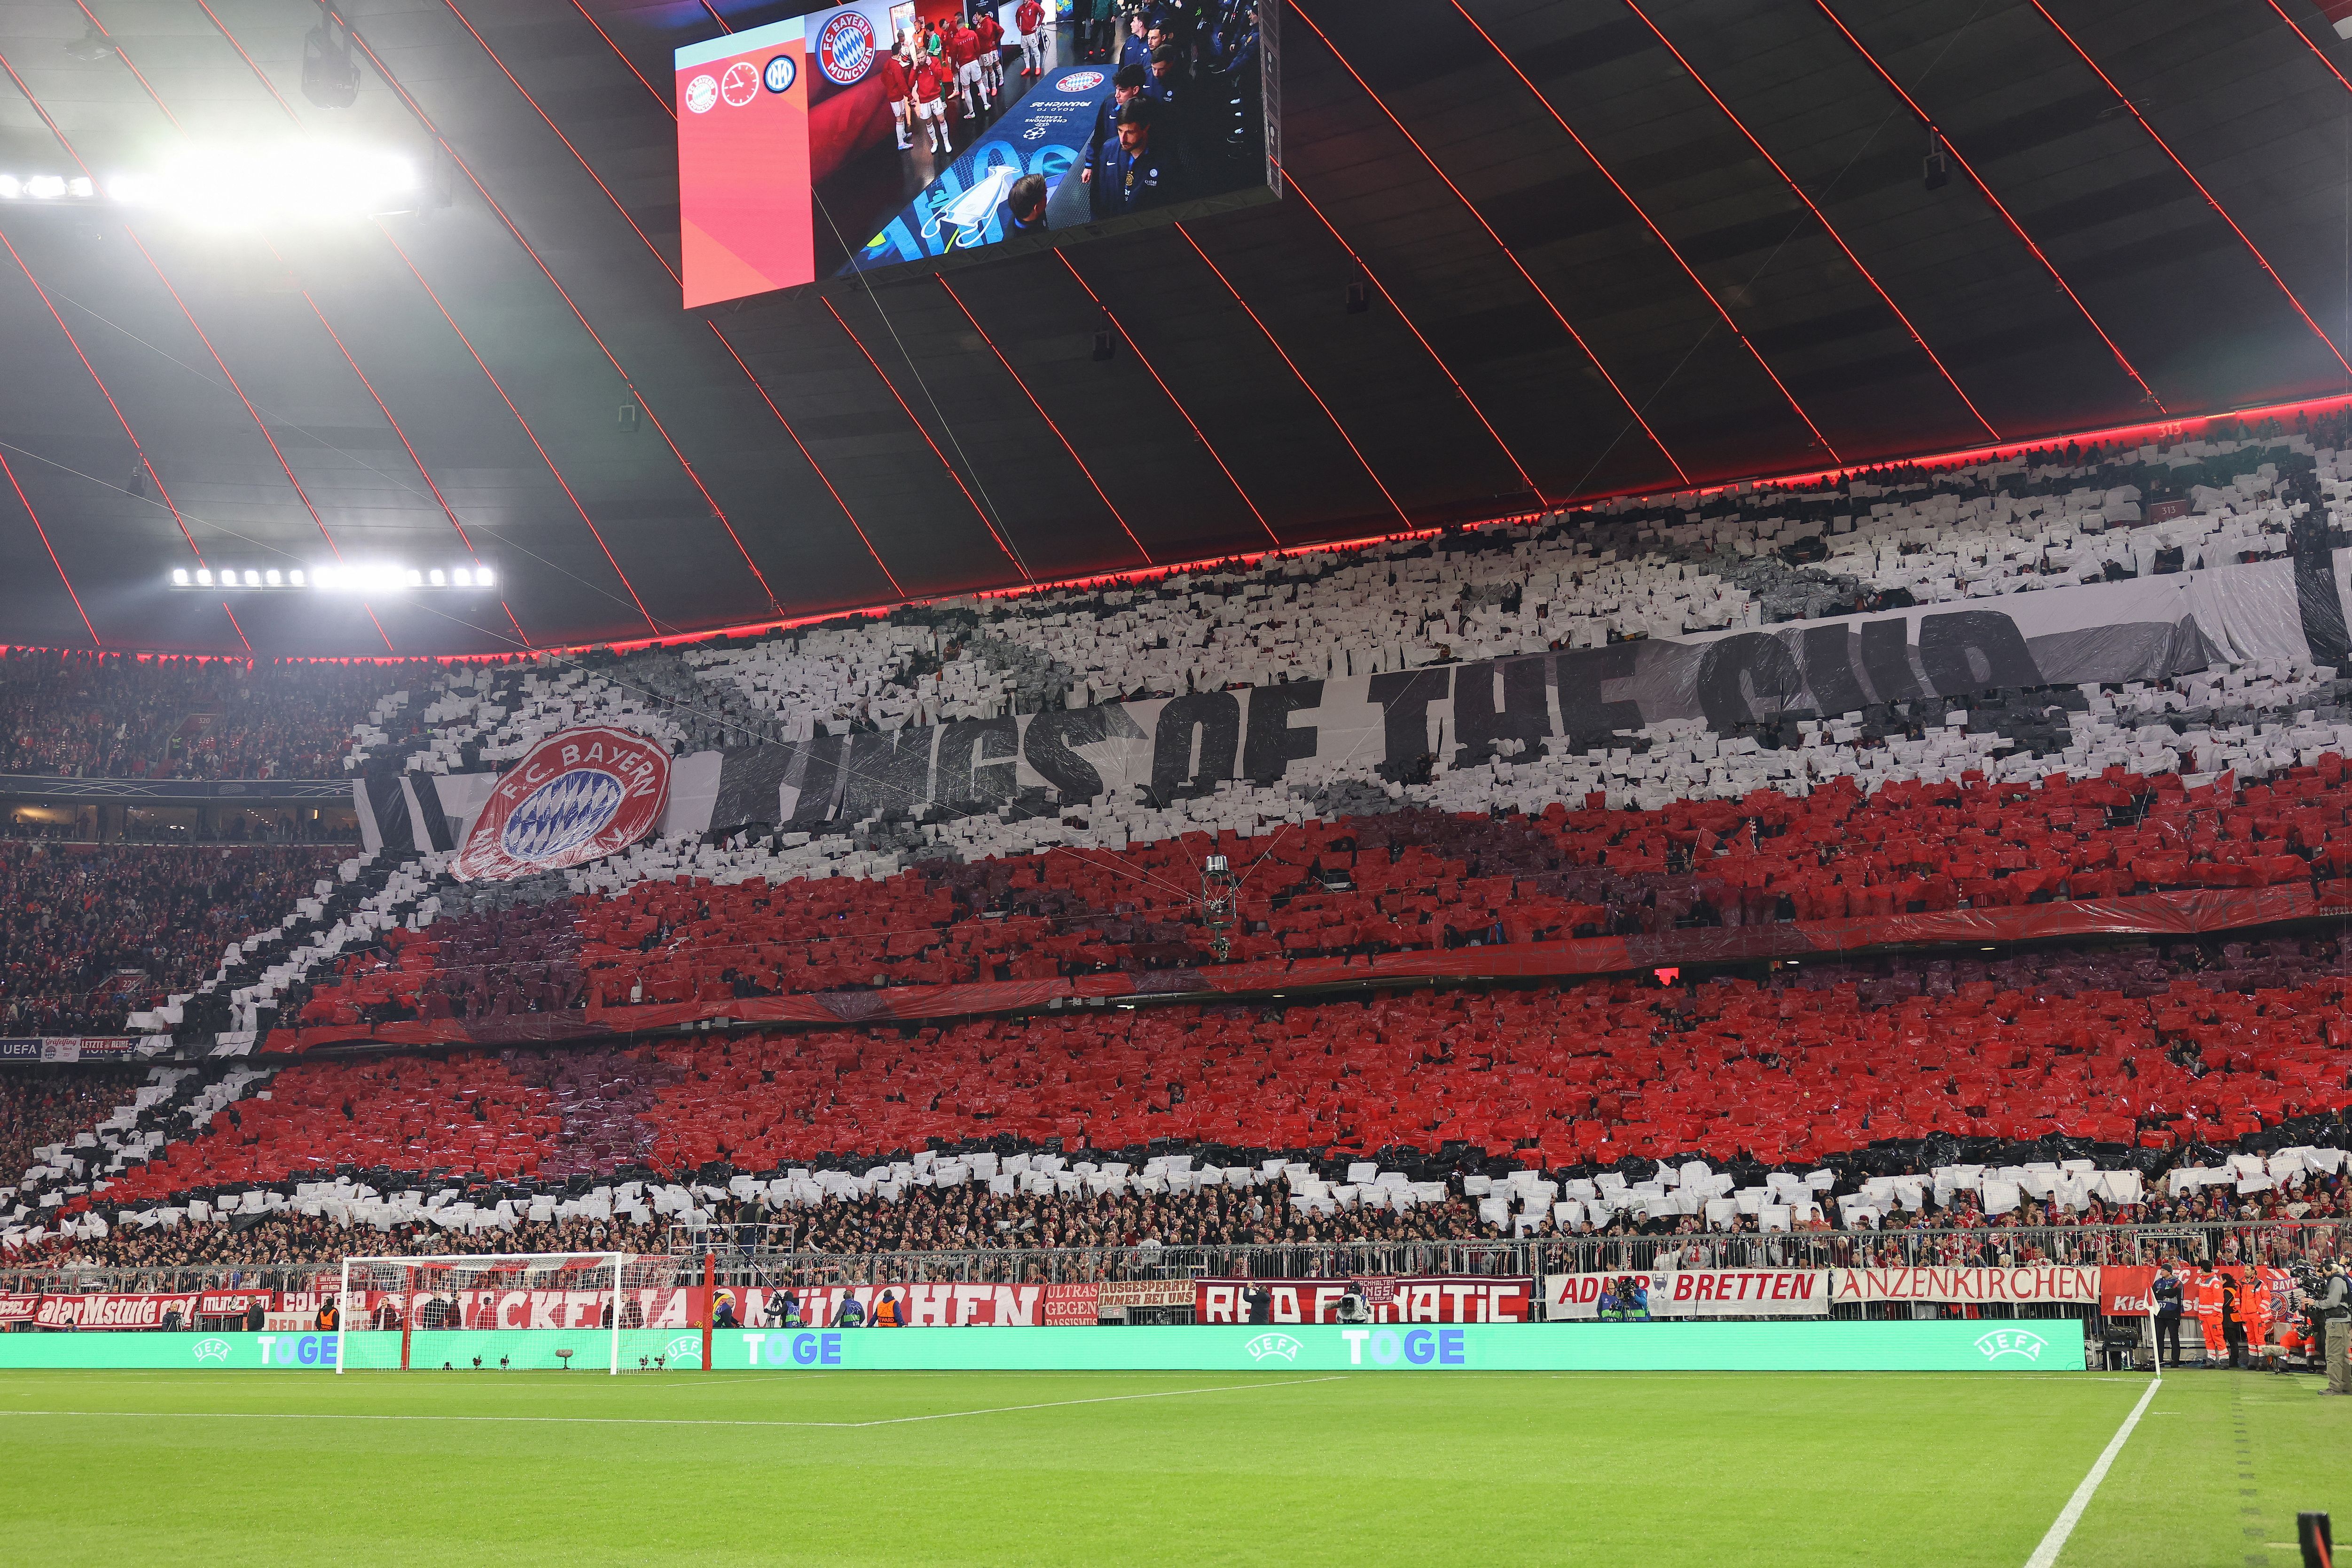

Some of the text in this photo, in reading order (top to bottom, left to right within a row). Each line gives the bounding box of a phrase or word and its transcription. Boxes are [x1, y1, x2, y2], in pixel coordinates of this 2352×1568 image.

[823, 16, 870, 51] FC BAYERN
[827, 47, 873, 80] MÜNCHEN
[931, 101, 939, 110] 27
[2158, 423, 2182, 438] 313
[2162, 506, 2176, 515] 313
[1152, 680, 1325, 809] OF
[1368, 644, 1647, 776] THE
[1698, 610, 2046, 731] CUP
[562, 742, 657, 797] BAYERN
[3, 1045, 37, 1054] UEFA
[81, 1040, 104, 1049] LETZTE
[1047, 1285, 1098, 1298] ULTRAS
[1100, 1279, 1196, 1294] AUSGESPERRTE
[1673, 1273, 1816, 1301] BRETTEN
[1838, 1267, 2096, 1299] ANZENKIRCHEN
[203, 1295, 270, 1312] MÜNCHN
[1099, 1291, 1193, 1306] IMMER BEI UNS
[1045, 1301, 1098, 1316] GEGEN
[194, 1341, 229, 1360] UEFA
[743, 1333, 841, 1365] TOGE
[1248, 1329, 1465, 1364] UEFA TOGE
[1978, 1333, 2041, 1359] UEFA
